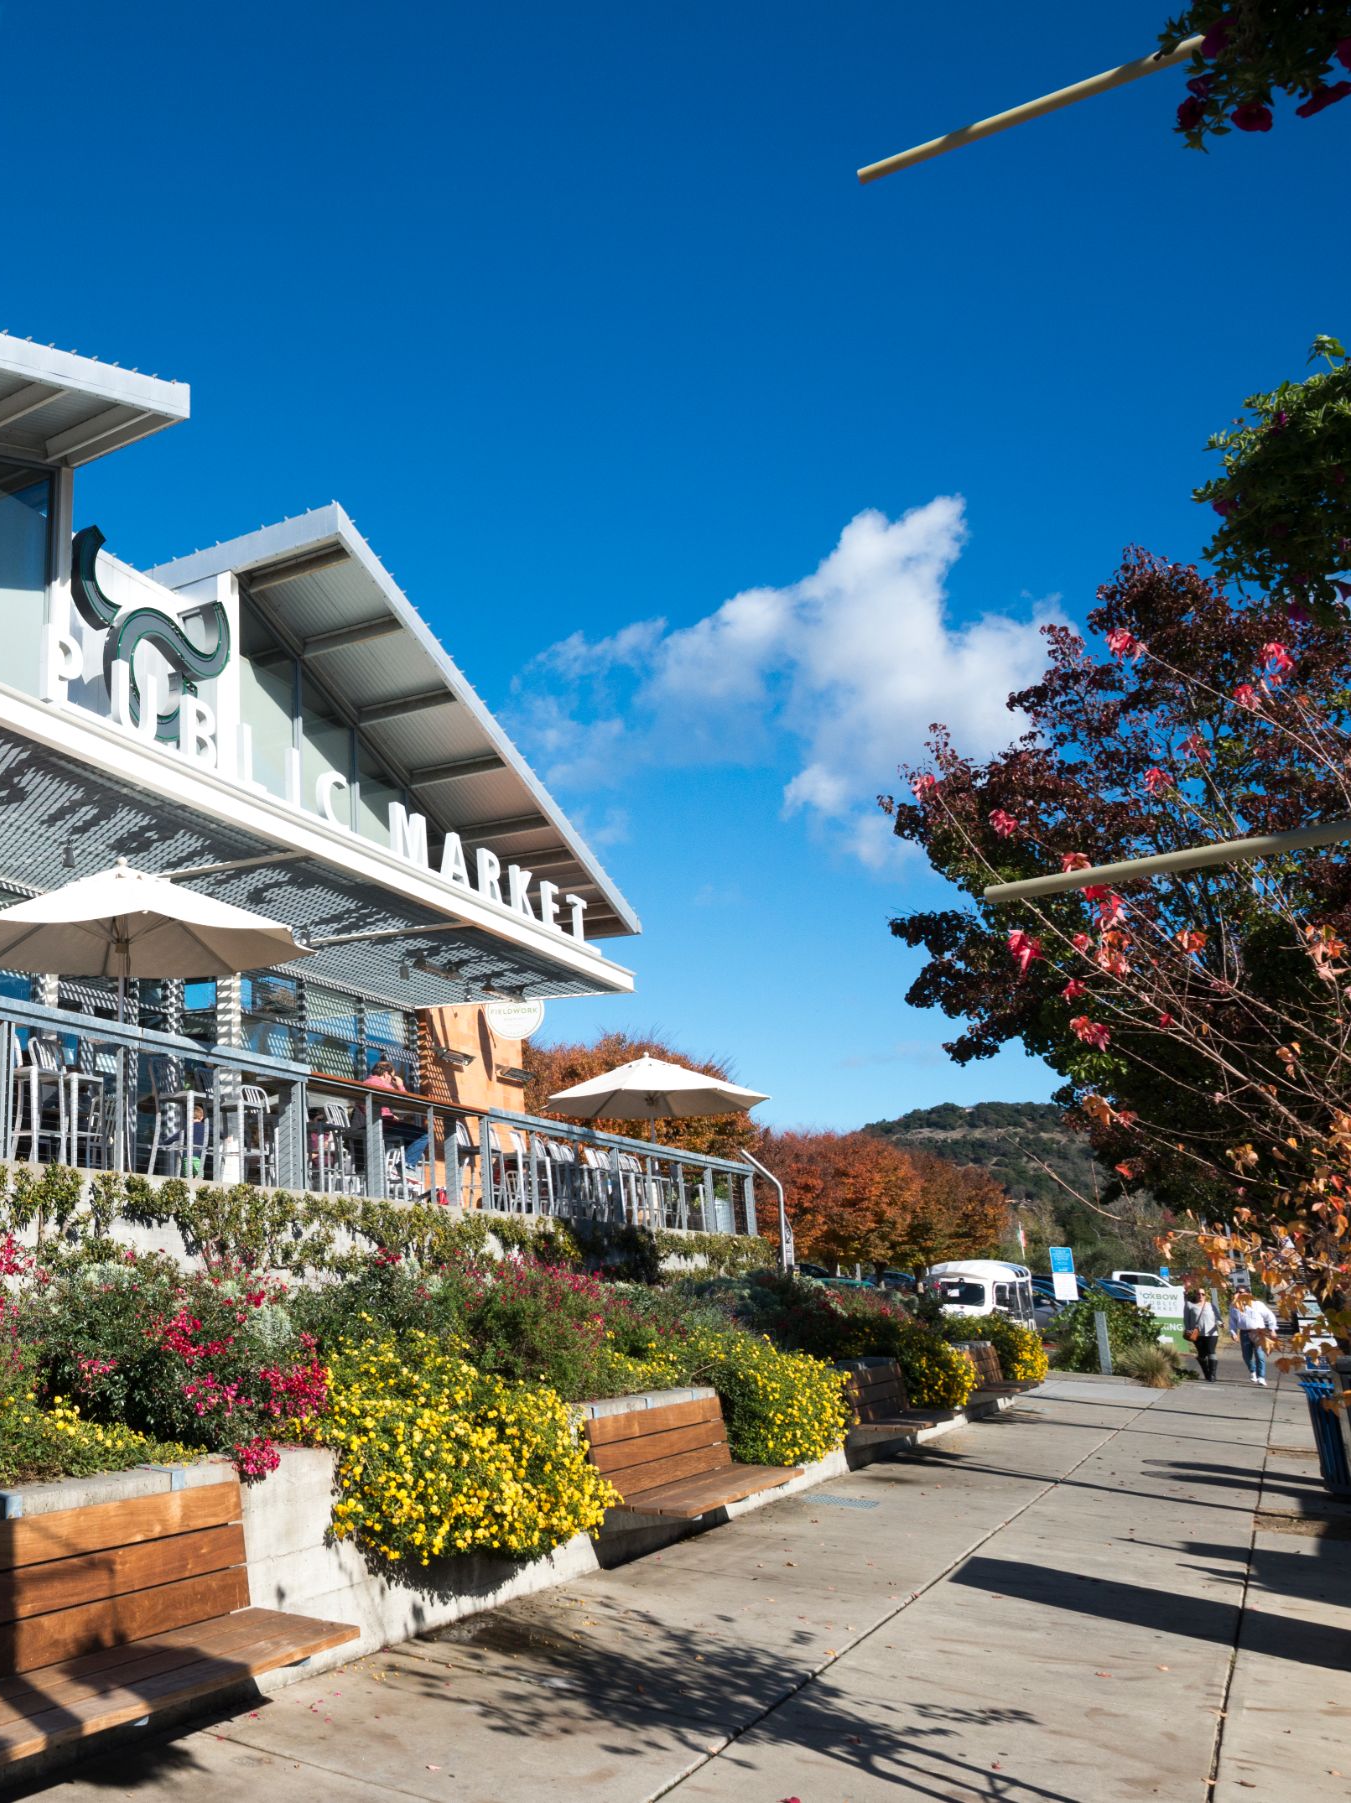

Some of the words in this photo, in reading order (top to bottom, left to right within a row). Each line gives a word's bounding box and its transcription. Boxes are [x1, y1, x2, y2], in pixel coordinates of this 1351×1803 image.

[41, 623, 350, 831] PUBLIC
[388, 801, 588, 942] MARKET
[490, 1007, 537, 1015] FIELDWORK
[1142, 1292, 1178, 1300] OXBOW
